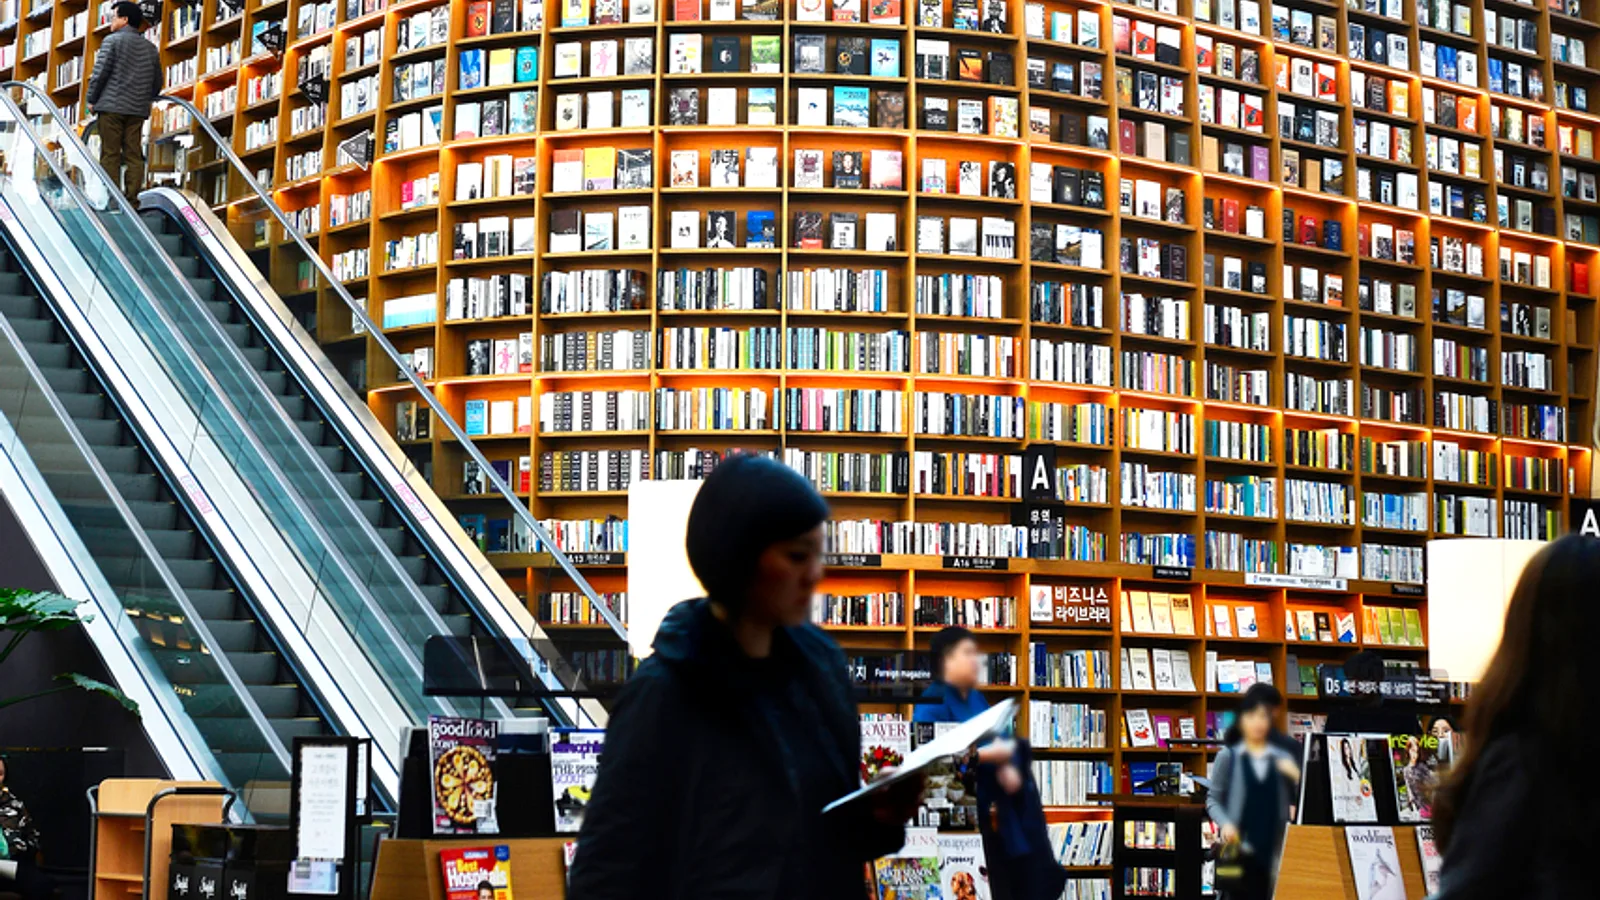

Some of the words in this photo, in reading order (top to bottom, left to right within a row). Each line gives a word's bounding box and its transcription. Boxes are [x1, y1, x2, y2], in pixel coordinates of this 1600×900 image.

[1031, 455, 1050, 490] A
[1580, 508, 1600, 537] A
[1055, 586, 1109, 605] 비즈니스
[1055, 605, 1111, 623] 라이브러리
[901, 669, 931, 680] magazine
[456, 858, 478, 872] Best
[446, 864, 507, 890] Hospitals
